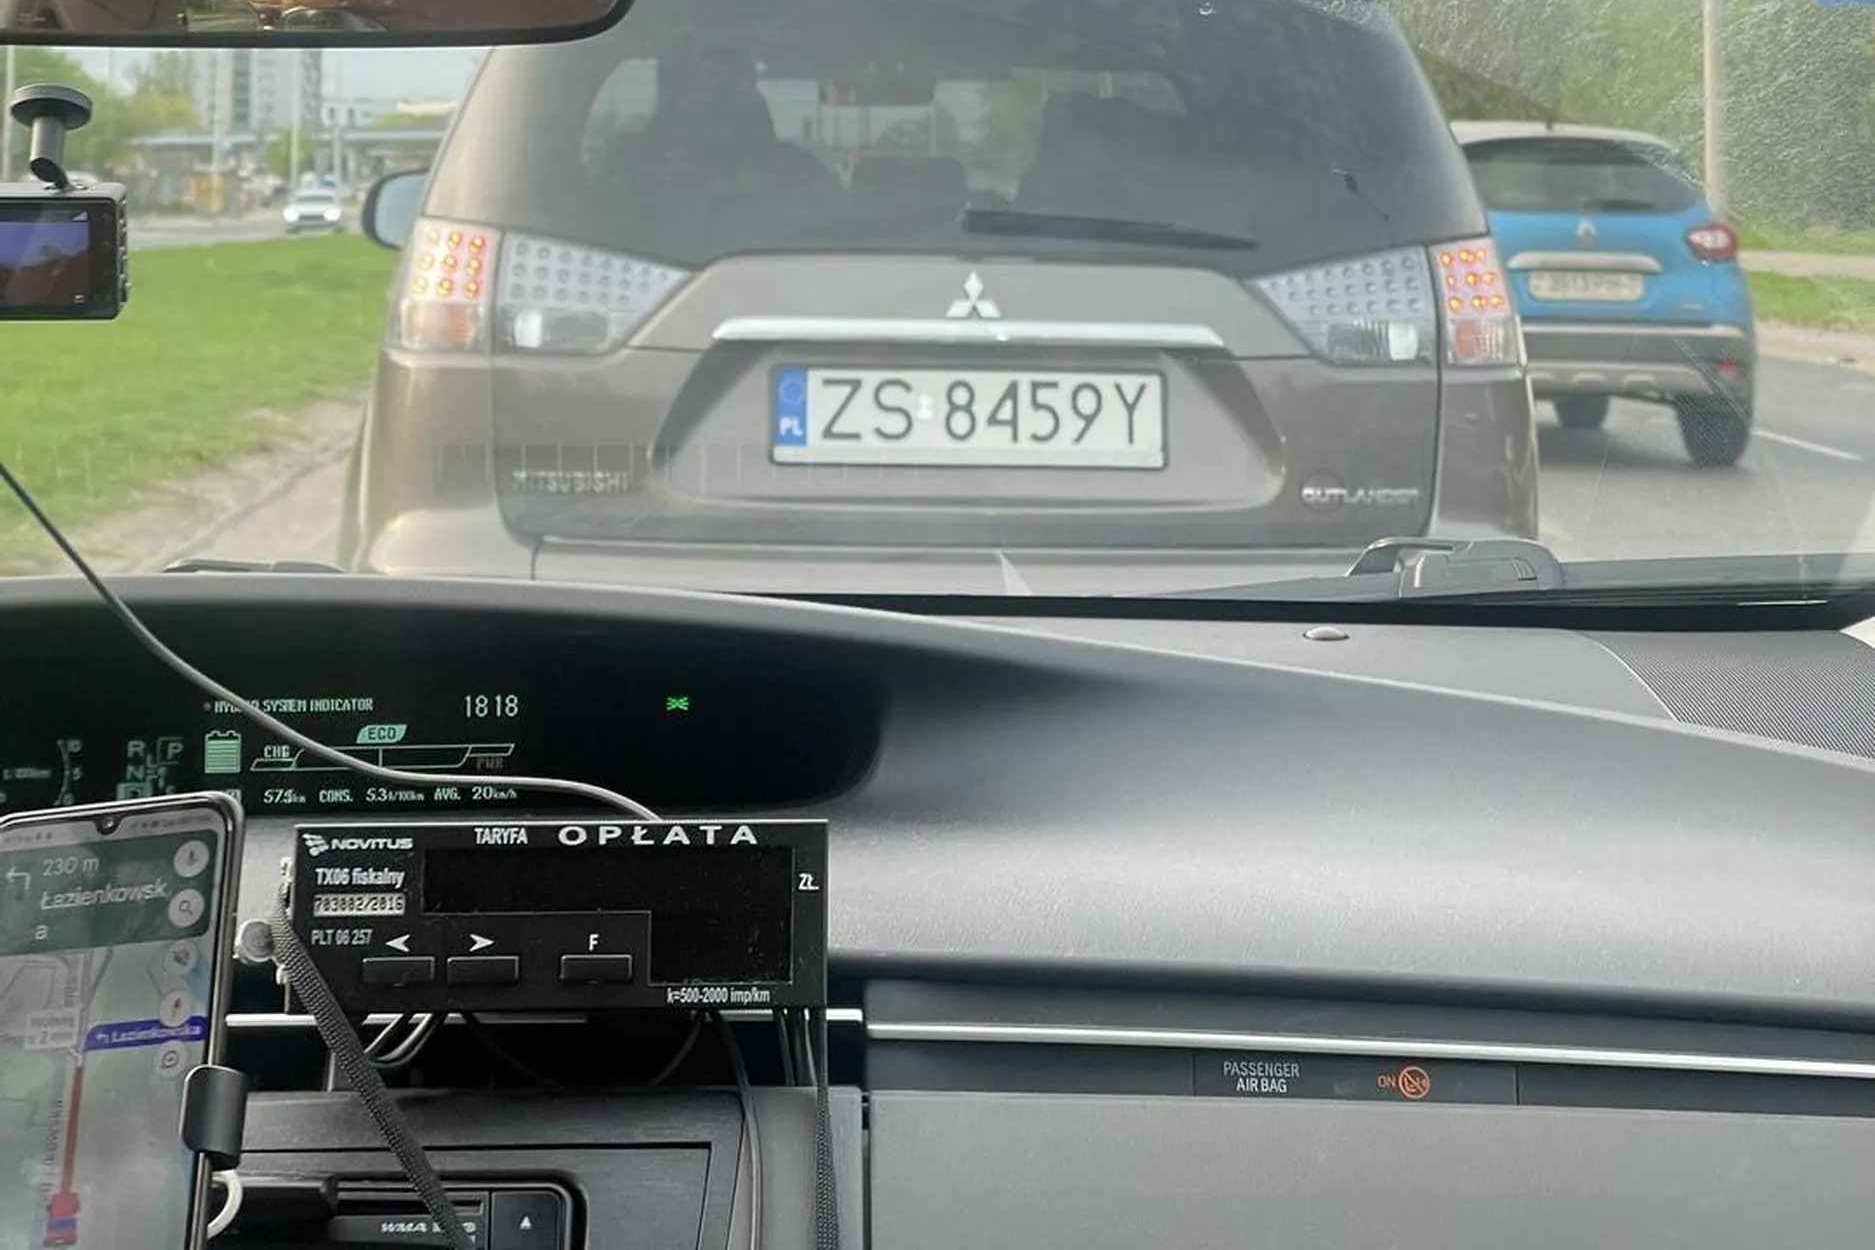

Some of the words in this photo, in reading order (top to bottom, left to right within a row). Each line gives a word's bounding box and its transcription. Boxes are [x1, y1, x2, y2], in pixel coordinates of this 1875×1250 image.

[821, 378, 914, 441] ZS
[944, 379, 1147, 445] 8459Y
[779, 417, 804, 437] PL
[262, 699, 307, 713] SYSTEM
[310, 698, 374, 712] INDICATOR
[367, 726, 398, 740] ECO
[127, 740, 146, 758] R
[263, 745, 291, 758] CHG
[331, 837, 414, 850] NOVITUS
[474, 827, 529, 845] TARYFA
[557, 825, 758, 846] OPŁATA
[42, 857, 77, 877] 230
[82, 857, 100, 872] m
[315, 867, 350, 886] TX06
[352, 866, 406, 890] fiskalny
[34, 924, 49, 941] a
[311, 929, 334, 946] PLT
[351, 928, 374, 946] 257
[589, 933, 600, 951] F
[730, 987, 771, 1005] imp/km
[1223, 1061, 1300, 1078] PASSENGER
[1377, 1075, 1396, 1089] ON
